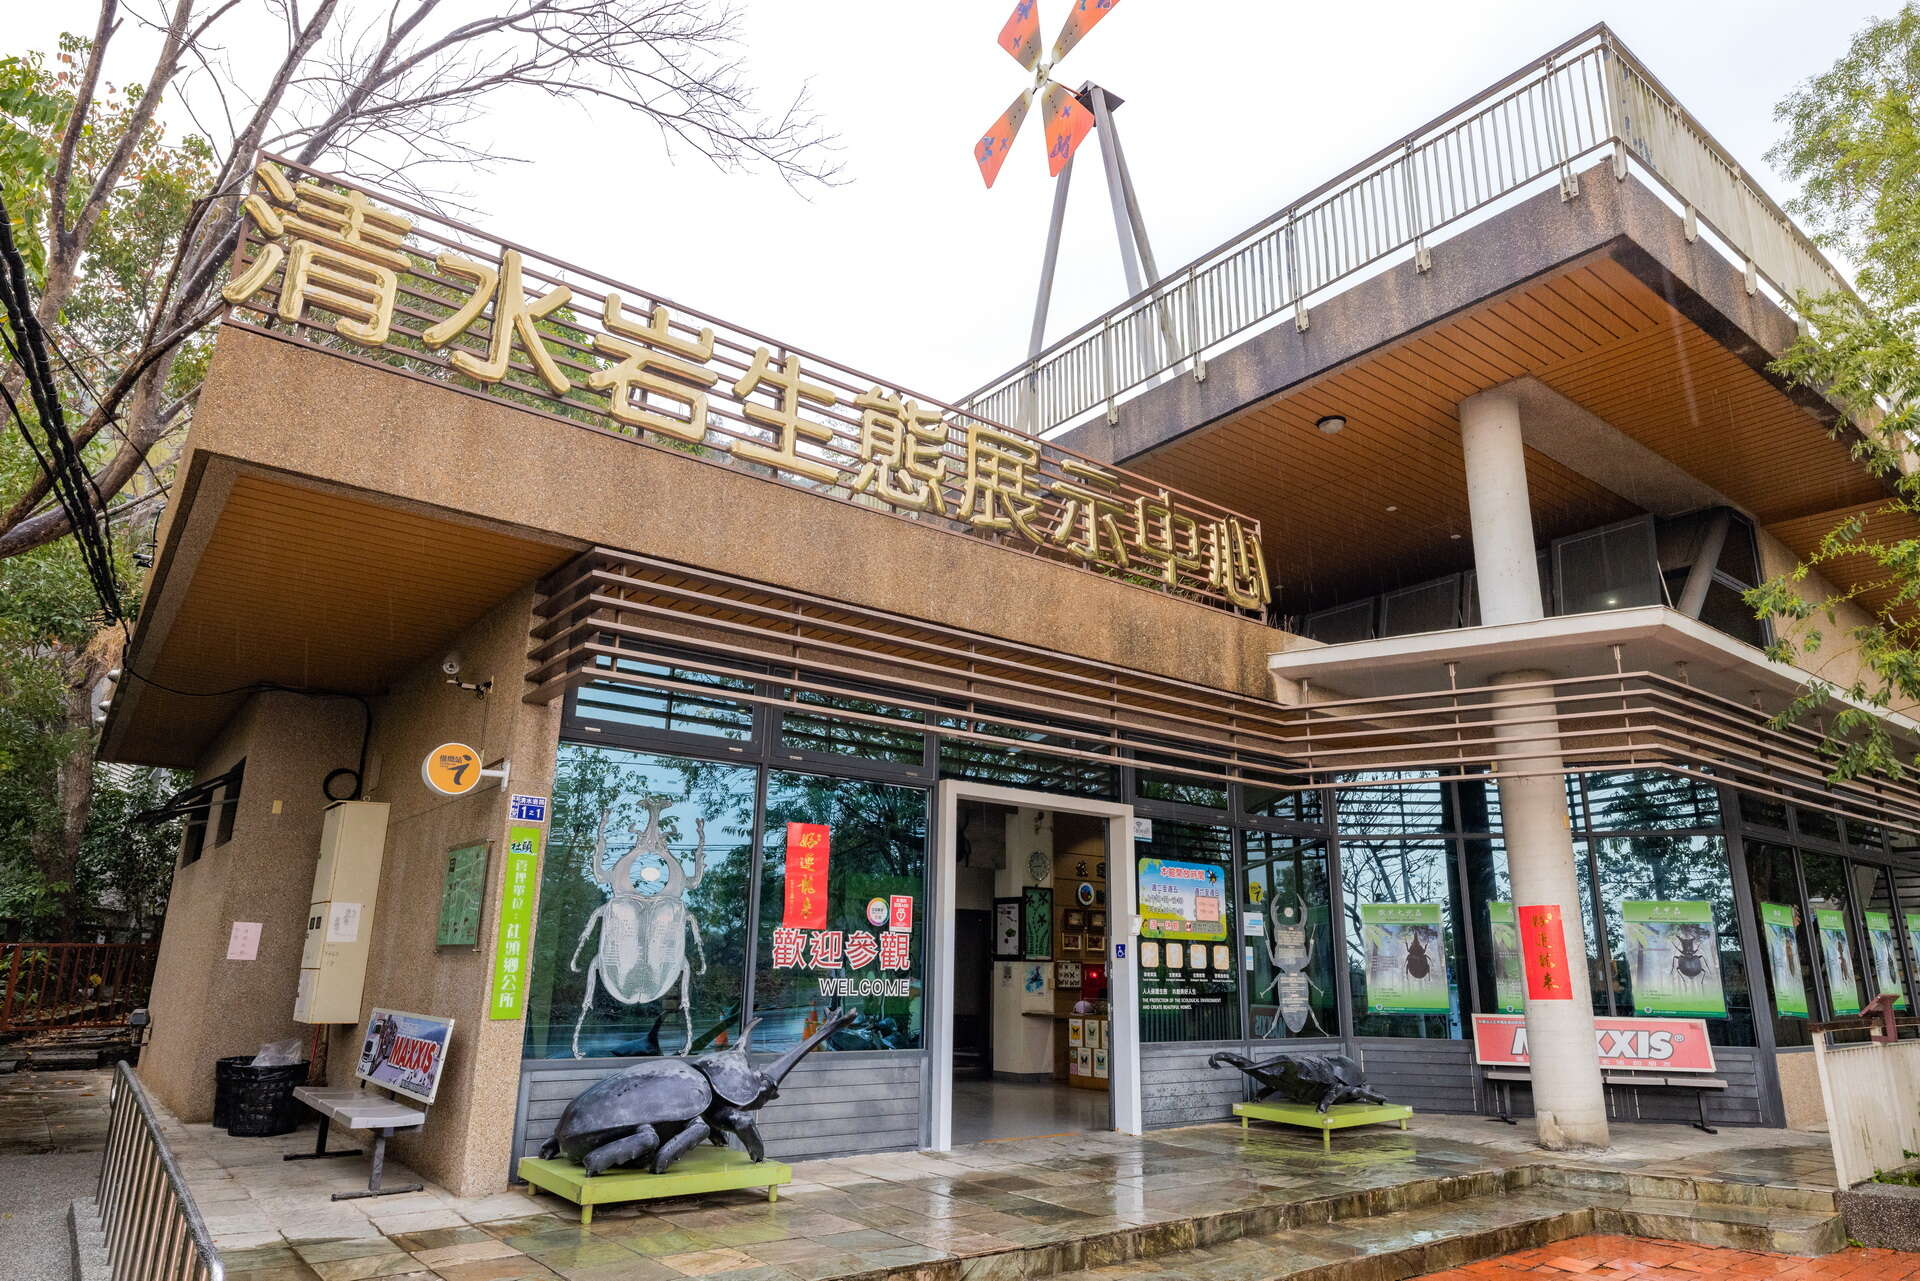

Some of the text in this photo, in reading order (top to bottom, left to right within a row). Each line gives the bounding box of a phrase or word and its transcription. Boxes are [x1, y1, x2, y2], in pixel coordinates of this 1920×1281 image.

[222, 161, 1272, 610] 清水岩生態展示中心
[511, 840, 534, 854] 社頭
[772, 928, 912, 971] 歡迎參觀
[818, 977, 911, 997] WELCOME
[387, 1034, 437, 1074] MAXXIS
